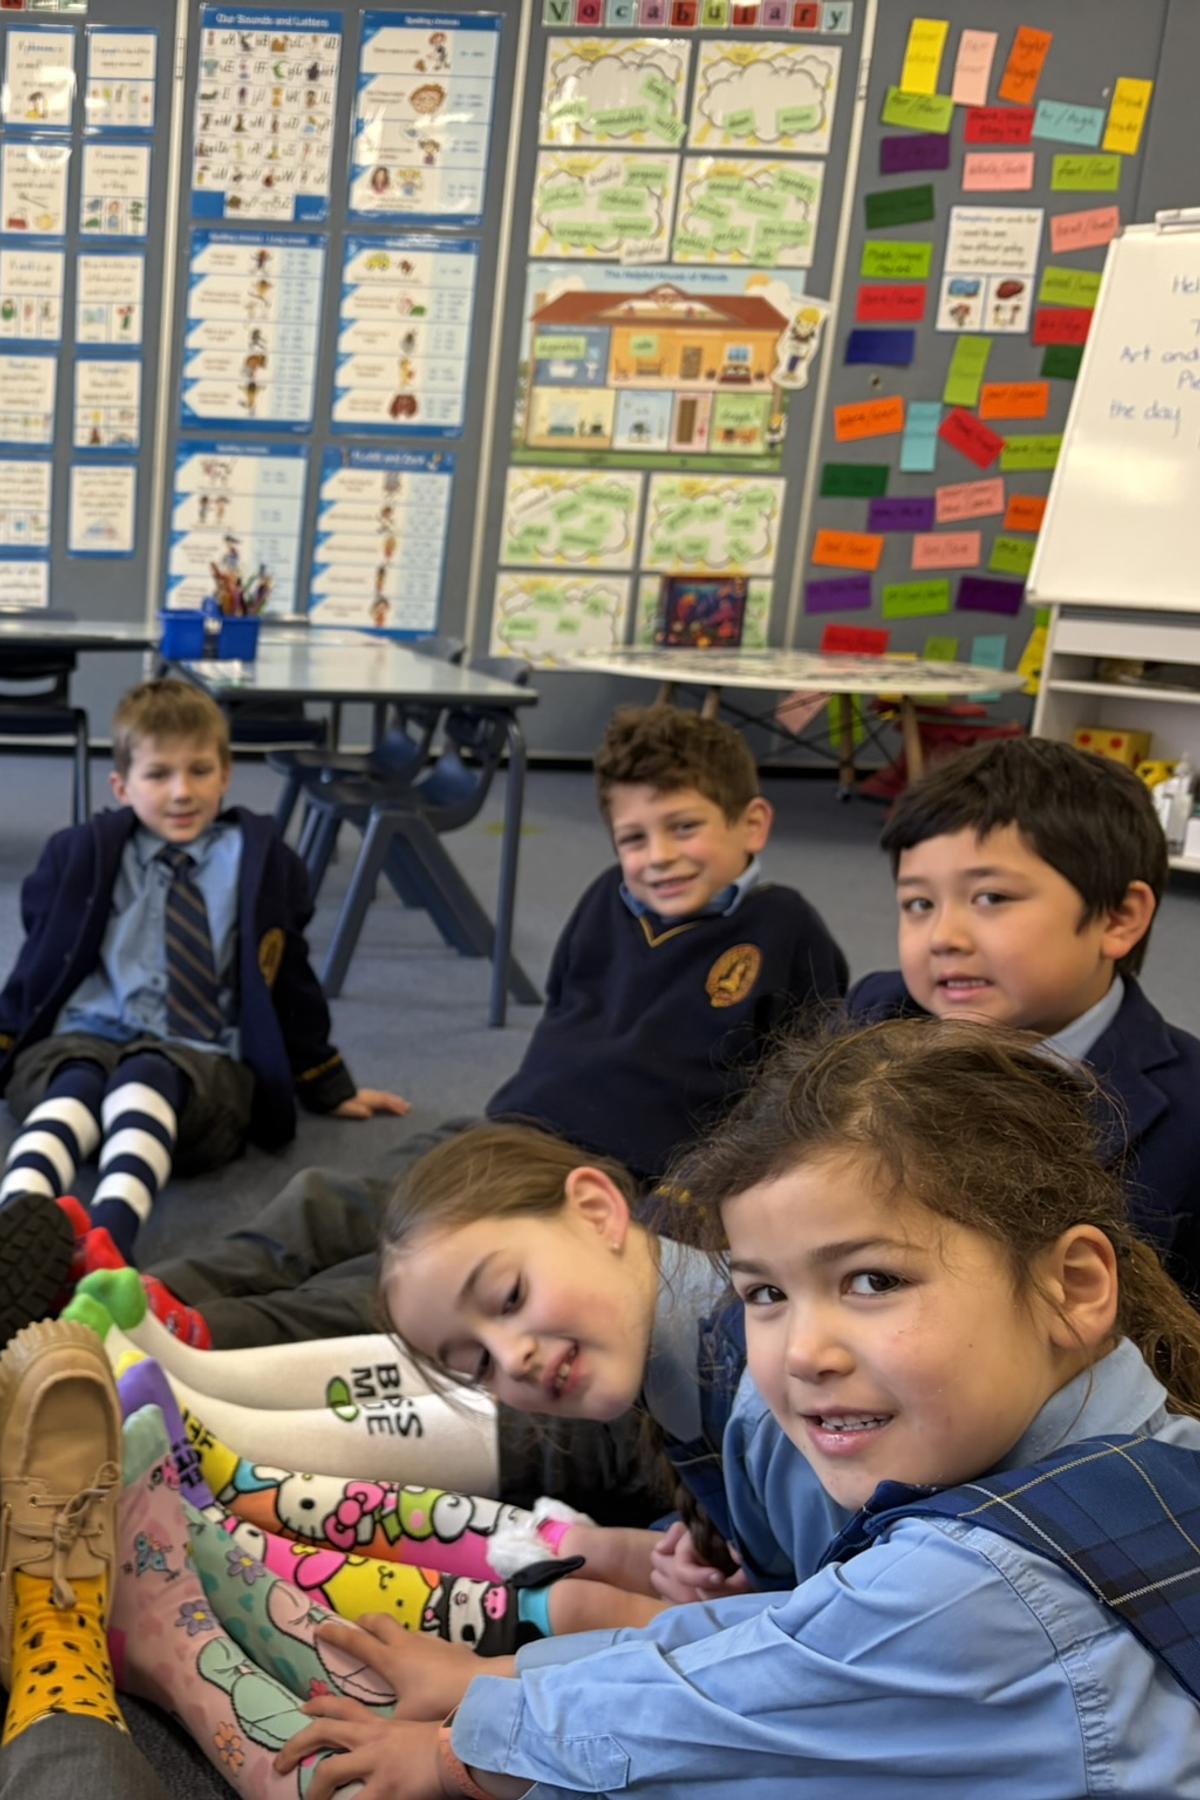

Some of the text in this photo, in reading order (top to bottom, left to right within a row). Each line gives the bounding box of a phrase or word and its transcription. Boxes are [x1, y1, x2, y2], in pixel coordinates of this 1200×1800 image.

[550, 1, 843, 29] Vocabulary
[1120, 345, 1150, 364] Art
[1144, 400, 1181, 440] day
